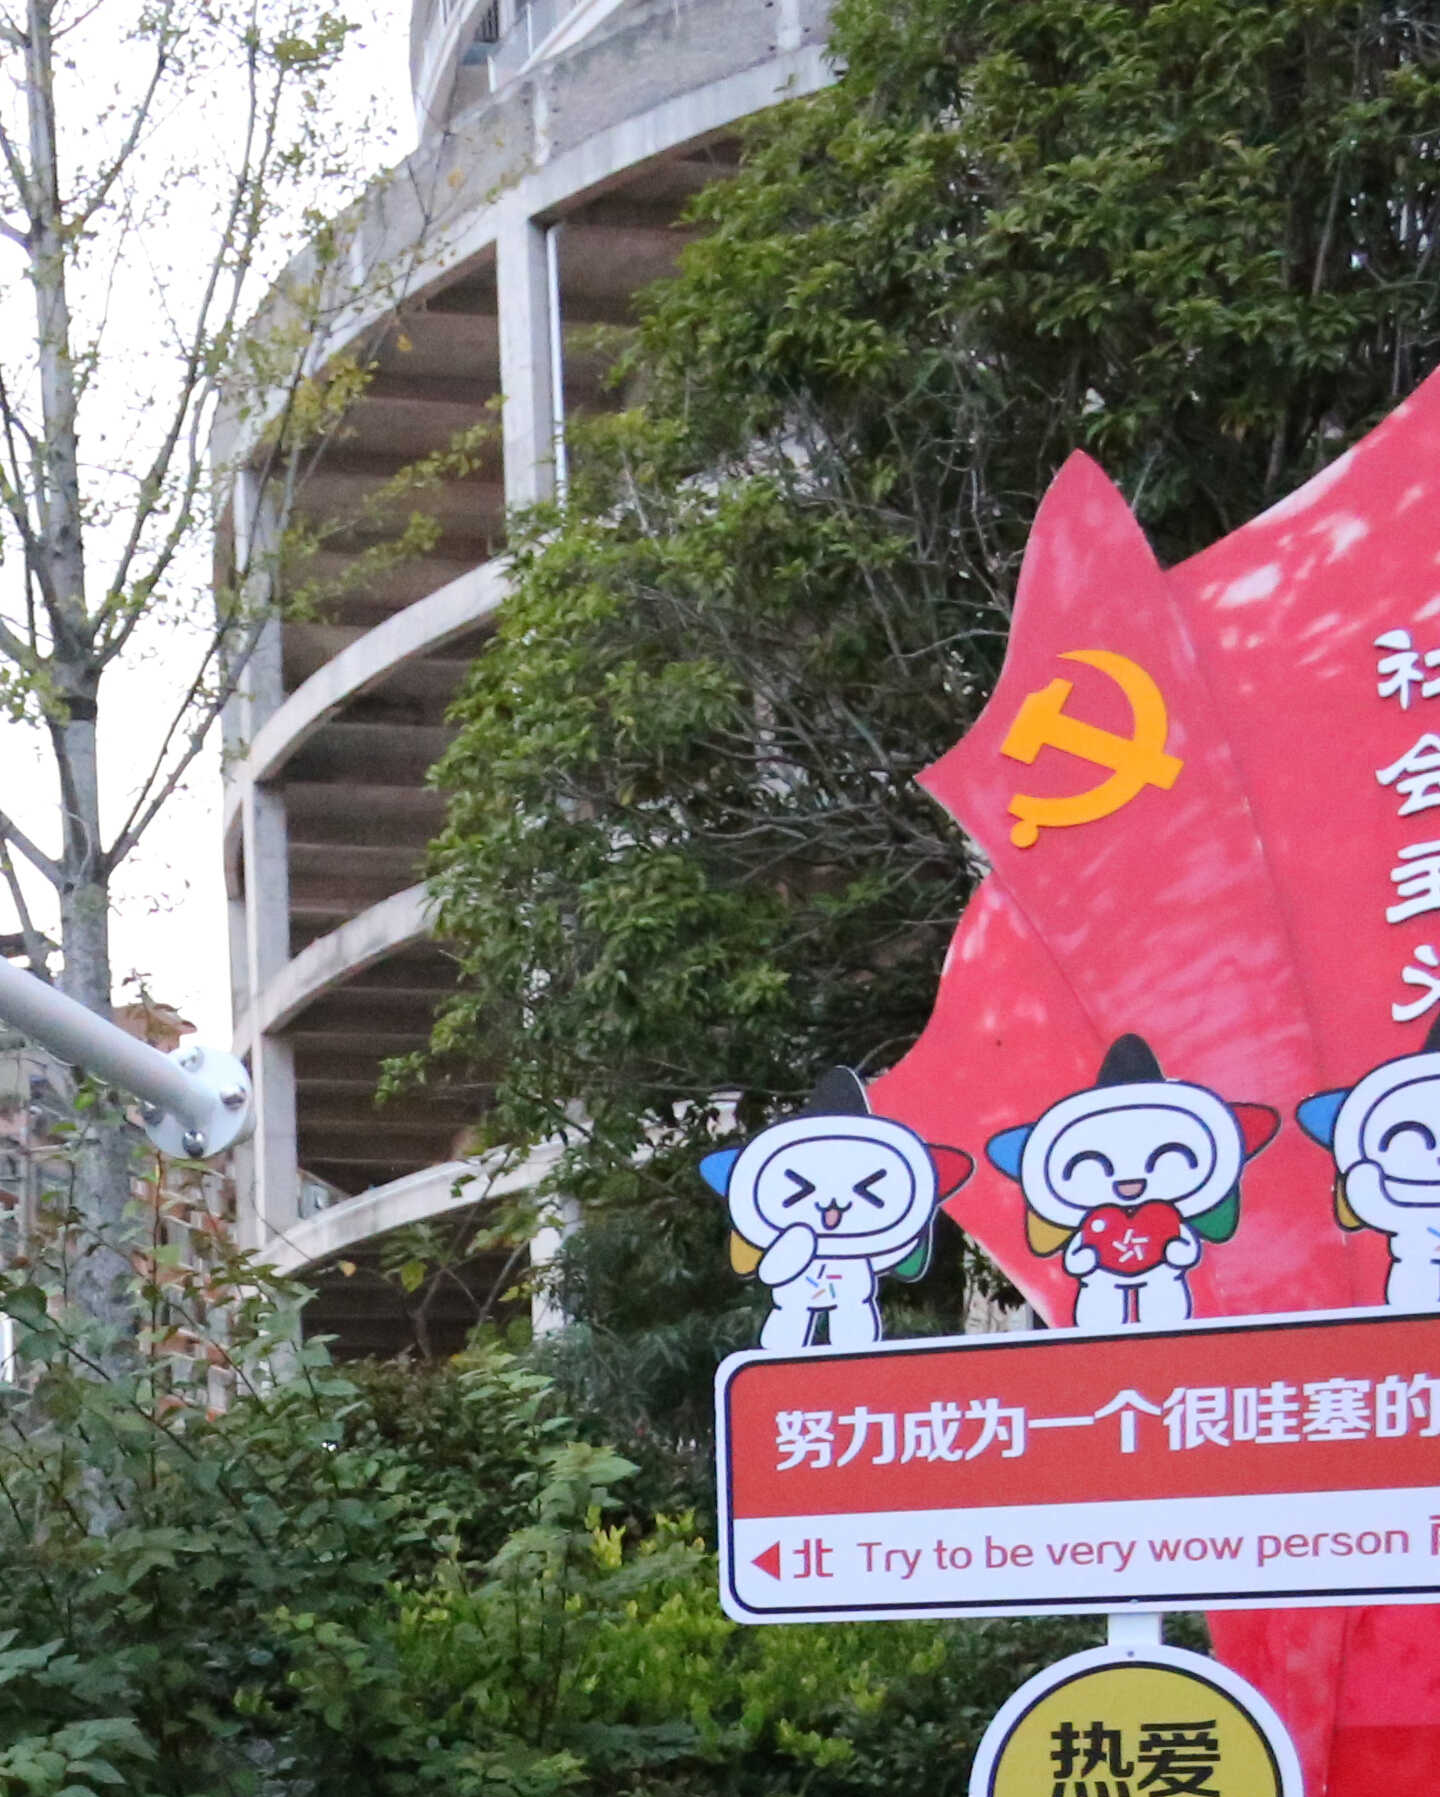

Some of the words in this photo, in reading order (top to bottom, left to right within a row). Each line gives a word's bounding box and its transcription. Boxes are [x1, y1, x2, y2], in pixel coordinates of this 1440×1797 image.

[793, 1538, 833, 1579] 北
[856, 1541, 921, 1580] Try
[934, 1540, 973, 1570] to
[984, 1534, 1034, 1568] be
[1046, 1536, 1136, 1572] very
[1146, 1532, 1244, 1563] wow
[1257, 1528, 1410, 1569] person
